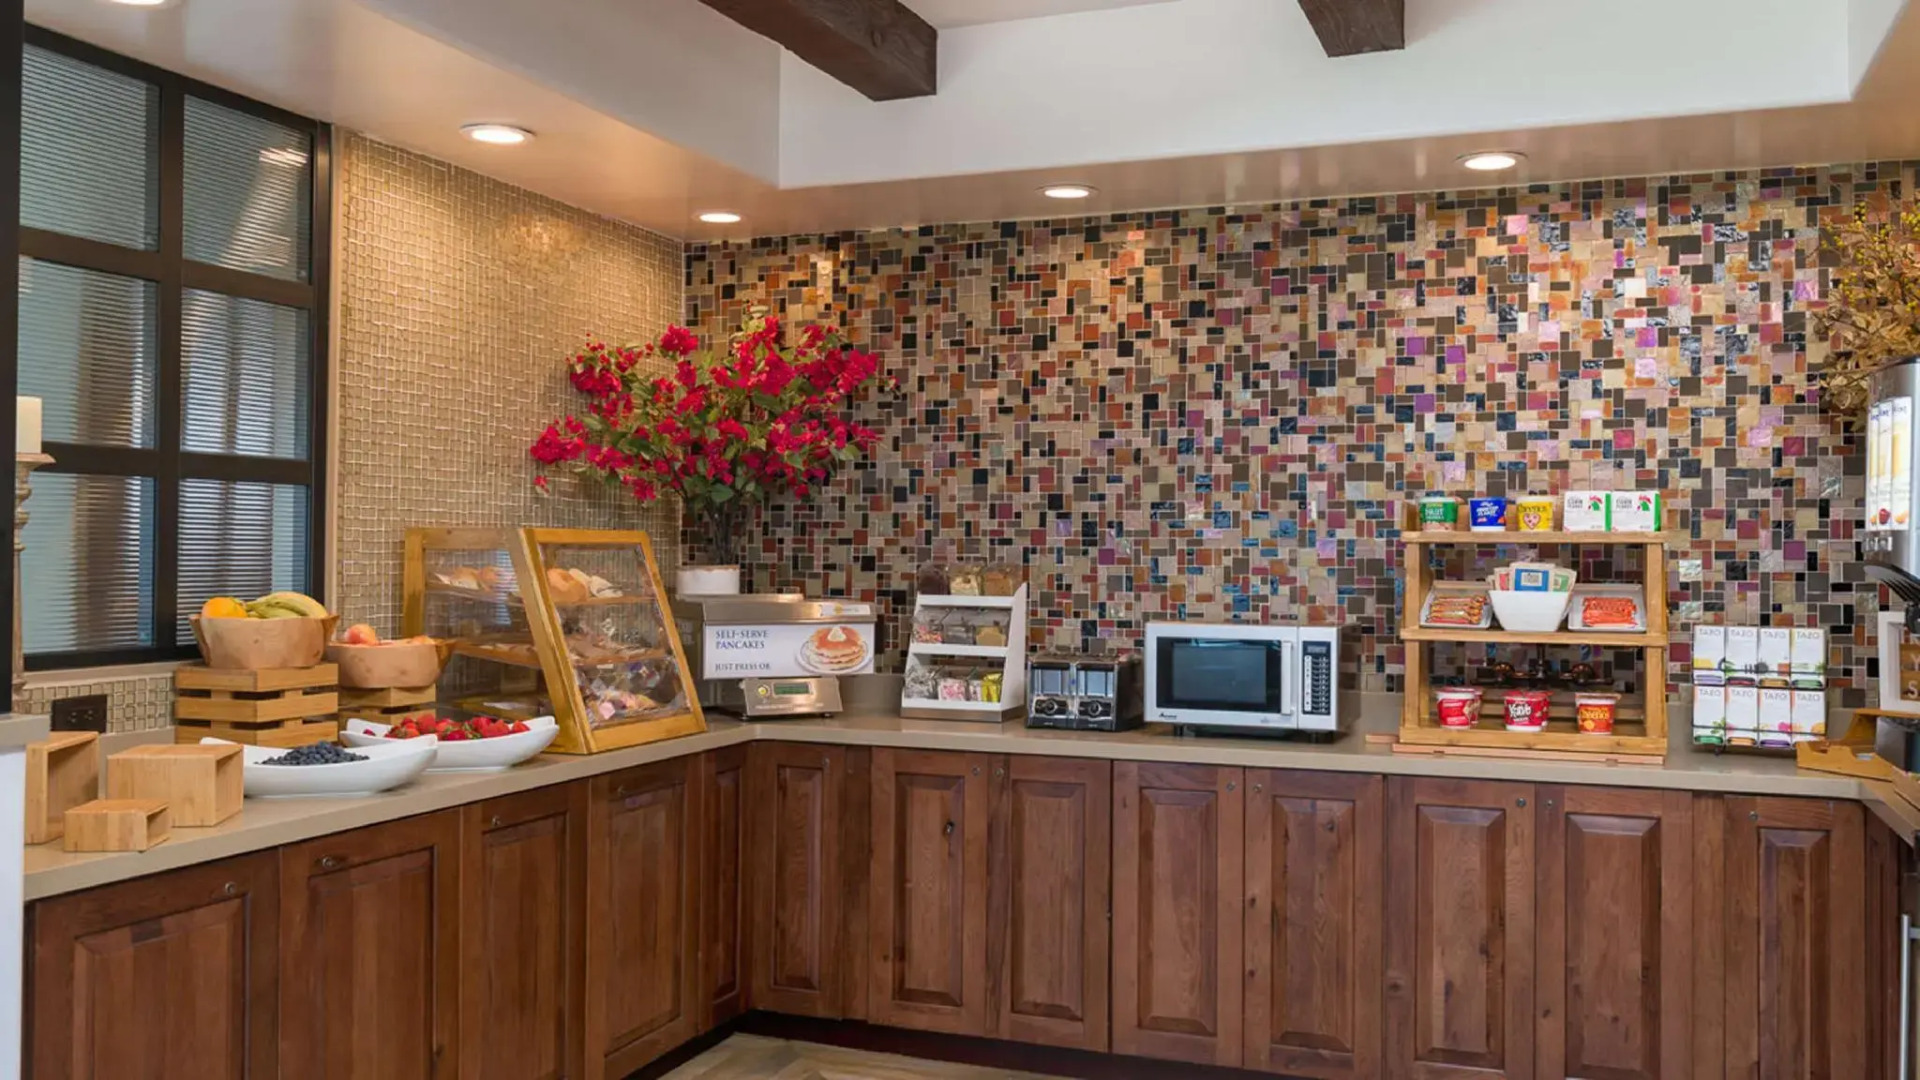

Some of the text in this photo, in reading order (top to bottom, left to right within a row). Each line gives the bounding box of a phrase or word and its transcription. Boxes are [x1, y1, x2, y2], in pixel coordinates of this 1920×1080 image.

[715, 629, 769, 639] SELF-SERVE
[1796, 631, 1820, 639] TAZO
[715, 640, 765, 649] PANCAKES
[715, 663, 733, 672] JUST
[1797, 693, 1821, 702] TAZO
